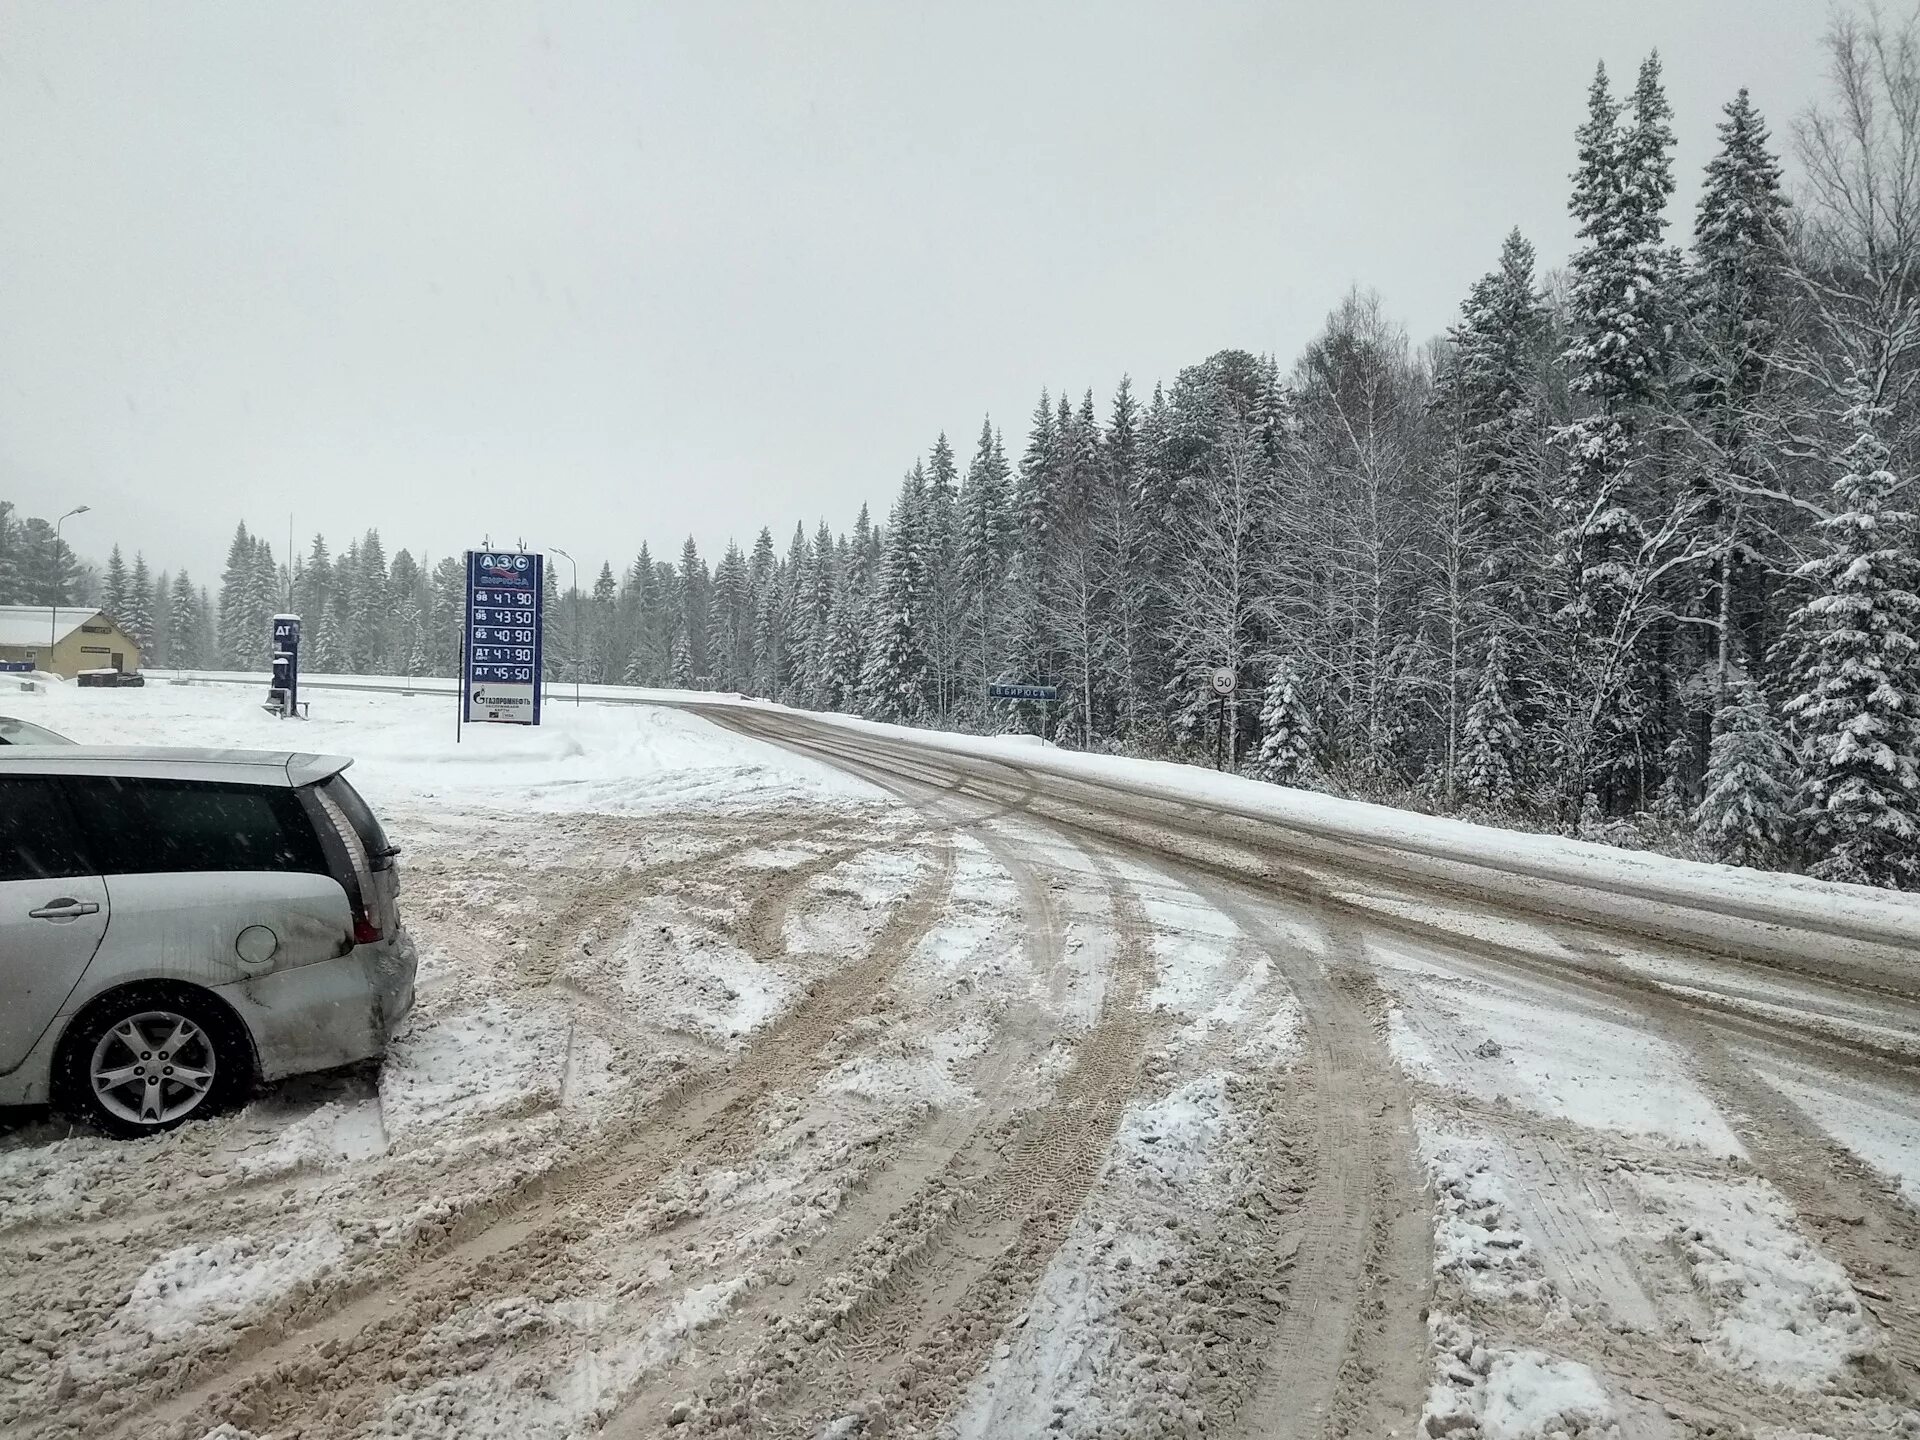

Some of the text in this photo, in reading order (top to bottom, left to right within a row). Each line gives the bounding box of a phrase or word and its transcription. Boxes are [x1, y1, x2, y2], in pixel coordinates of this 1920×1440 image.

[482, 556, 527, 568] АЗС
[476, 593, 488, 601] 98
[475, 612, 487, 621] 95
[276, 625, 290, 636] ДТ
[475, 631, 487, 639] 92
[475, 648, 489, 657] ДТ
[475, 667, 489, 676] ДТ
[1217, 677, 1231, 687] 50
[1004, 688, 1045, 696] БИРЮСА
[485, 697, 531, 705] ГАЗПРОМНЕФТЬ
